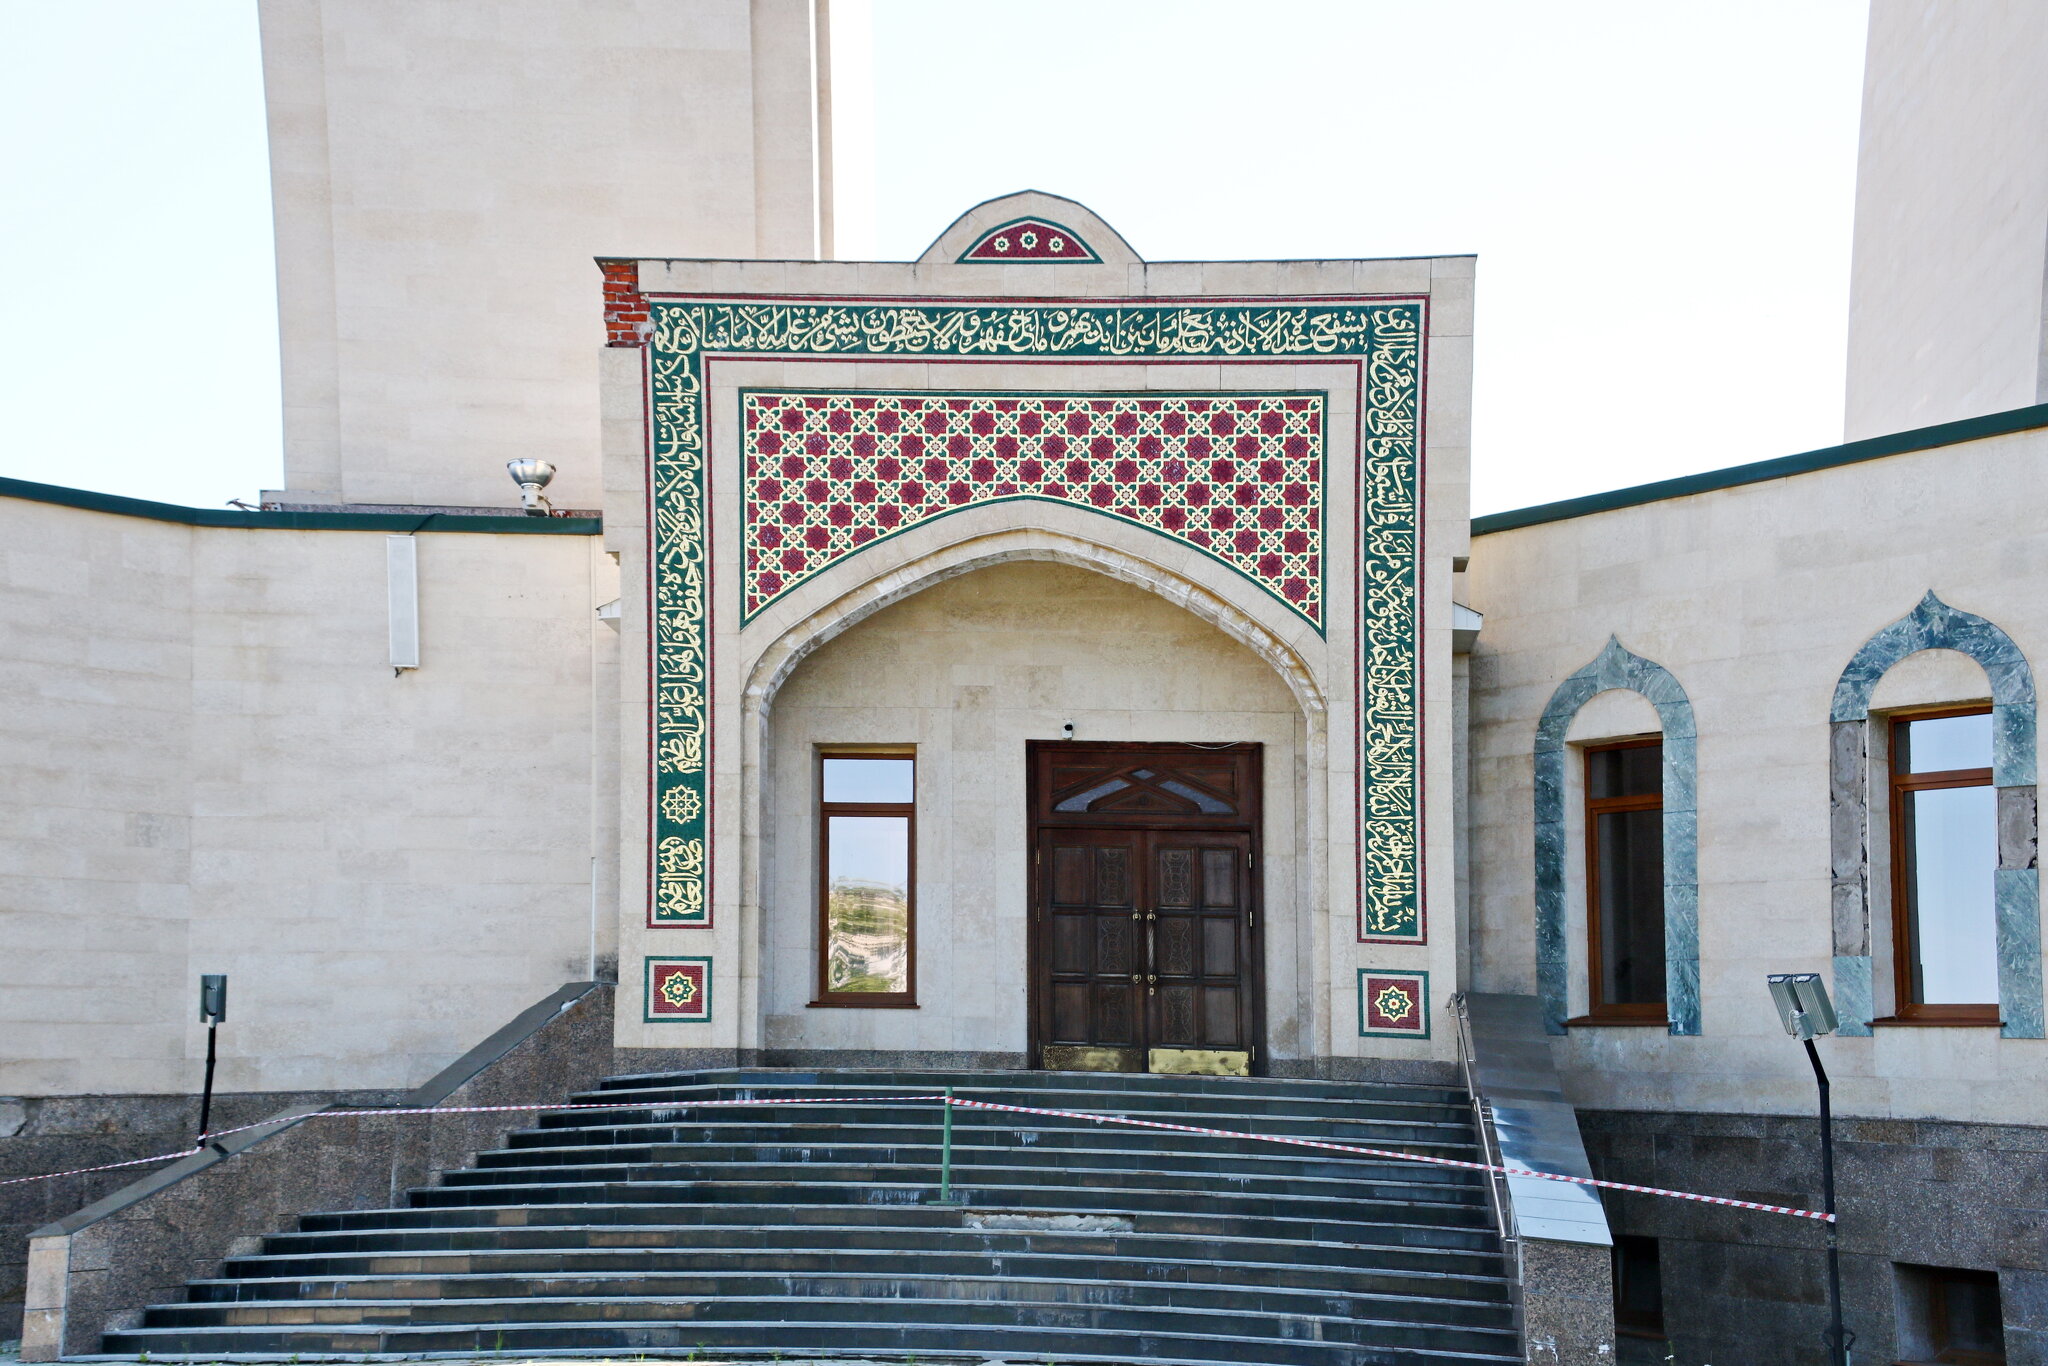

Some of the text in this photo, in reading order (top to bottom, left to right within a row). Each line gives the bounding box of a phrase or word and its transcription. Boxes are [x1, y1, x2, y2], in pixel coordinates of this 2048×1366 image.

[1366, 787, 1414, 819] الله
[1365, 821, 1414, 854] الرحيم
[1366, 838, 1414, 882] الرحمن
[1366, 887, 1414, 933] بسم
[1374, 884, 1414, 905] الله
